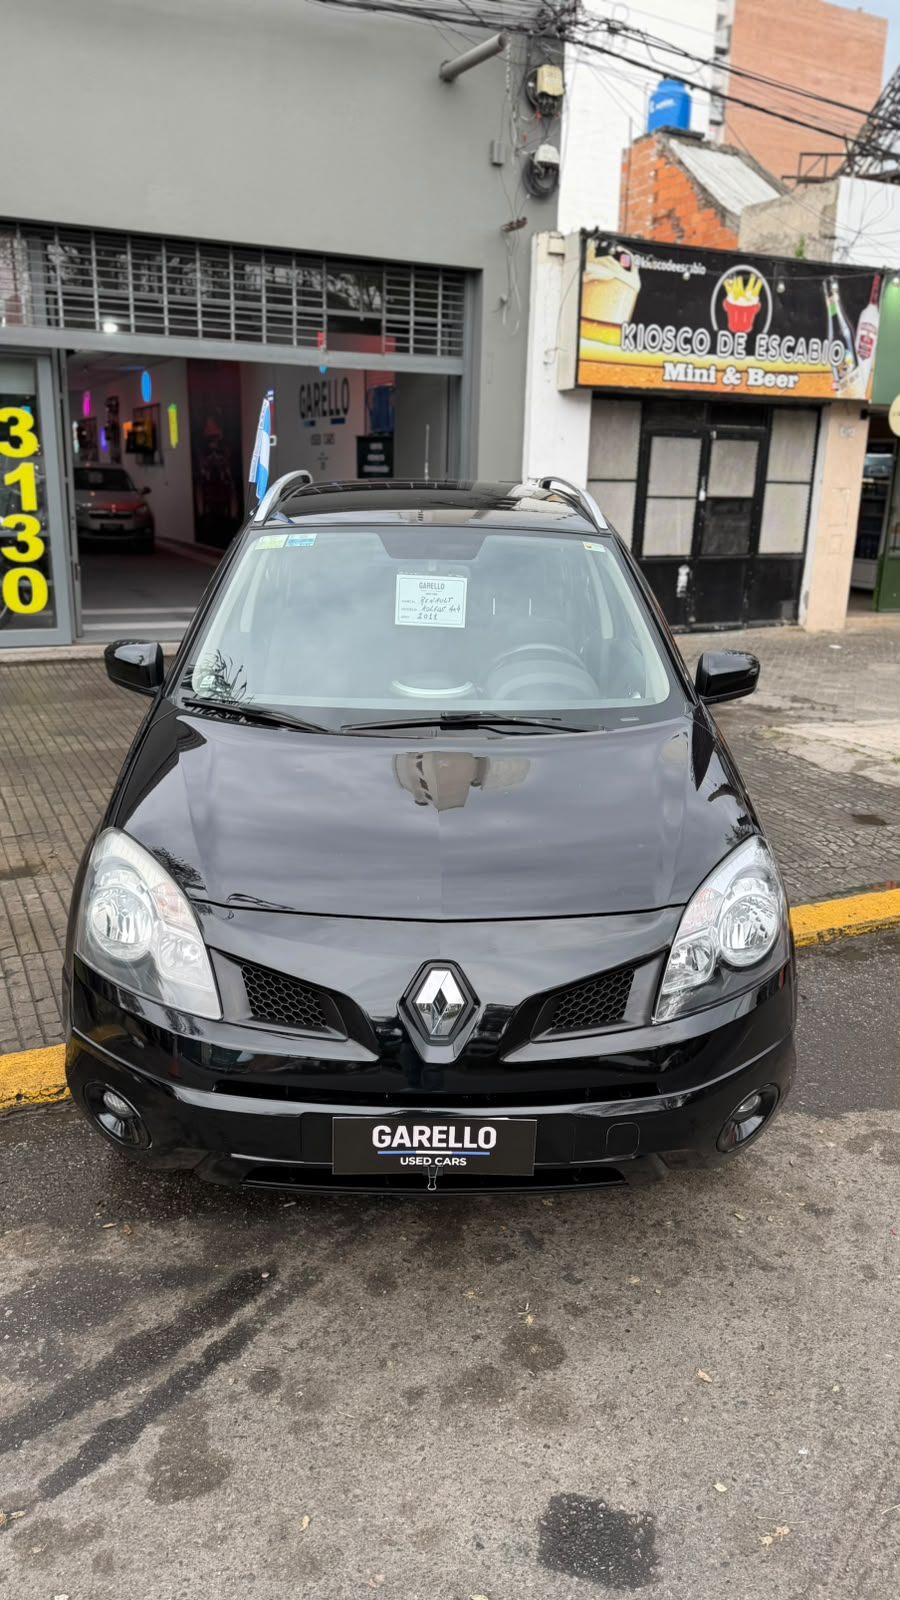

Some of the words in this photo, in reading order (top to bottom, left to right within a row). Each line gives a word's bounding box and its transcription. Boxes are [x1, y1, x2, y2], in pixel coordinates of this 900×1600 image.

[621, 323, 711, 356] KIOSCO
[716, 330, 746, 359] DE
[755, 334, 845, 366] ESCABIO
[663, 361, 716, 384] Mini
[722, 367, 742, 386] &
[746, 367, 799, 389] Beer
[372, 1125, 497, 1149] GARELLO
[400, 1157, 433, 1166] USED
[434, 1157, 467, 1166] CARS
